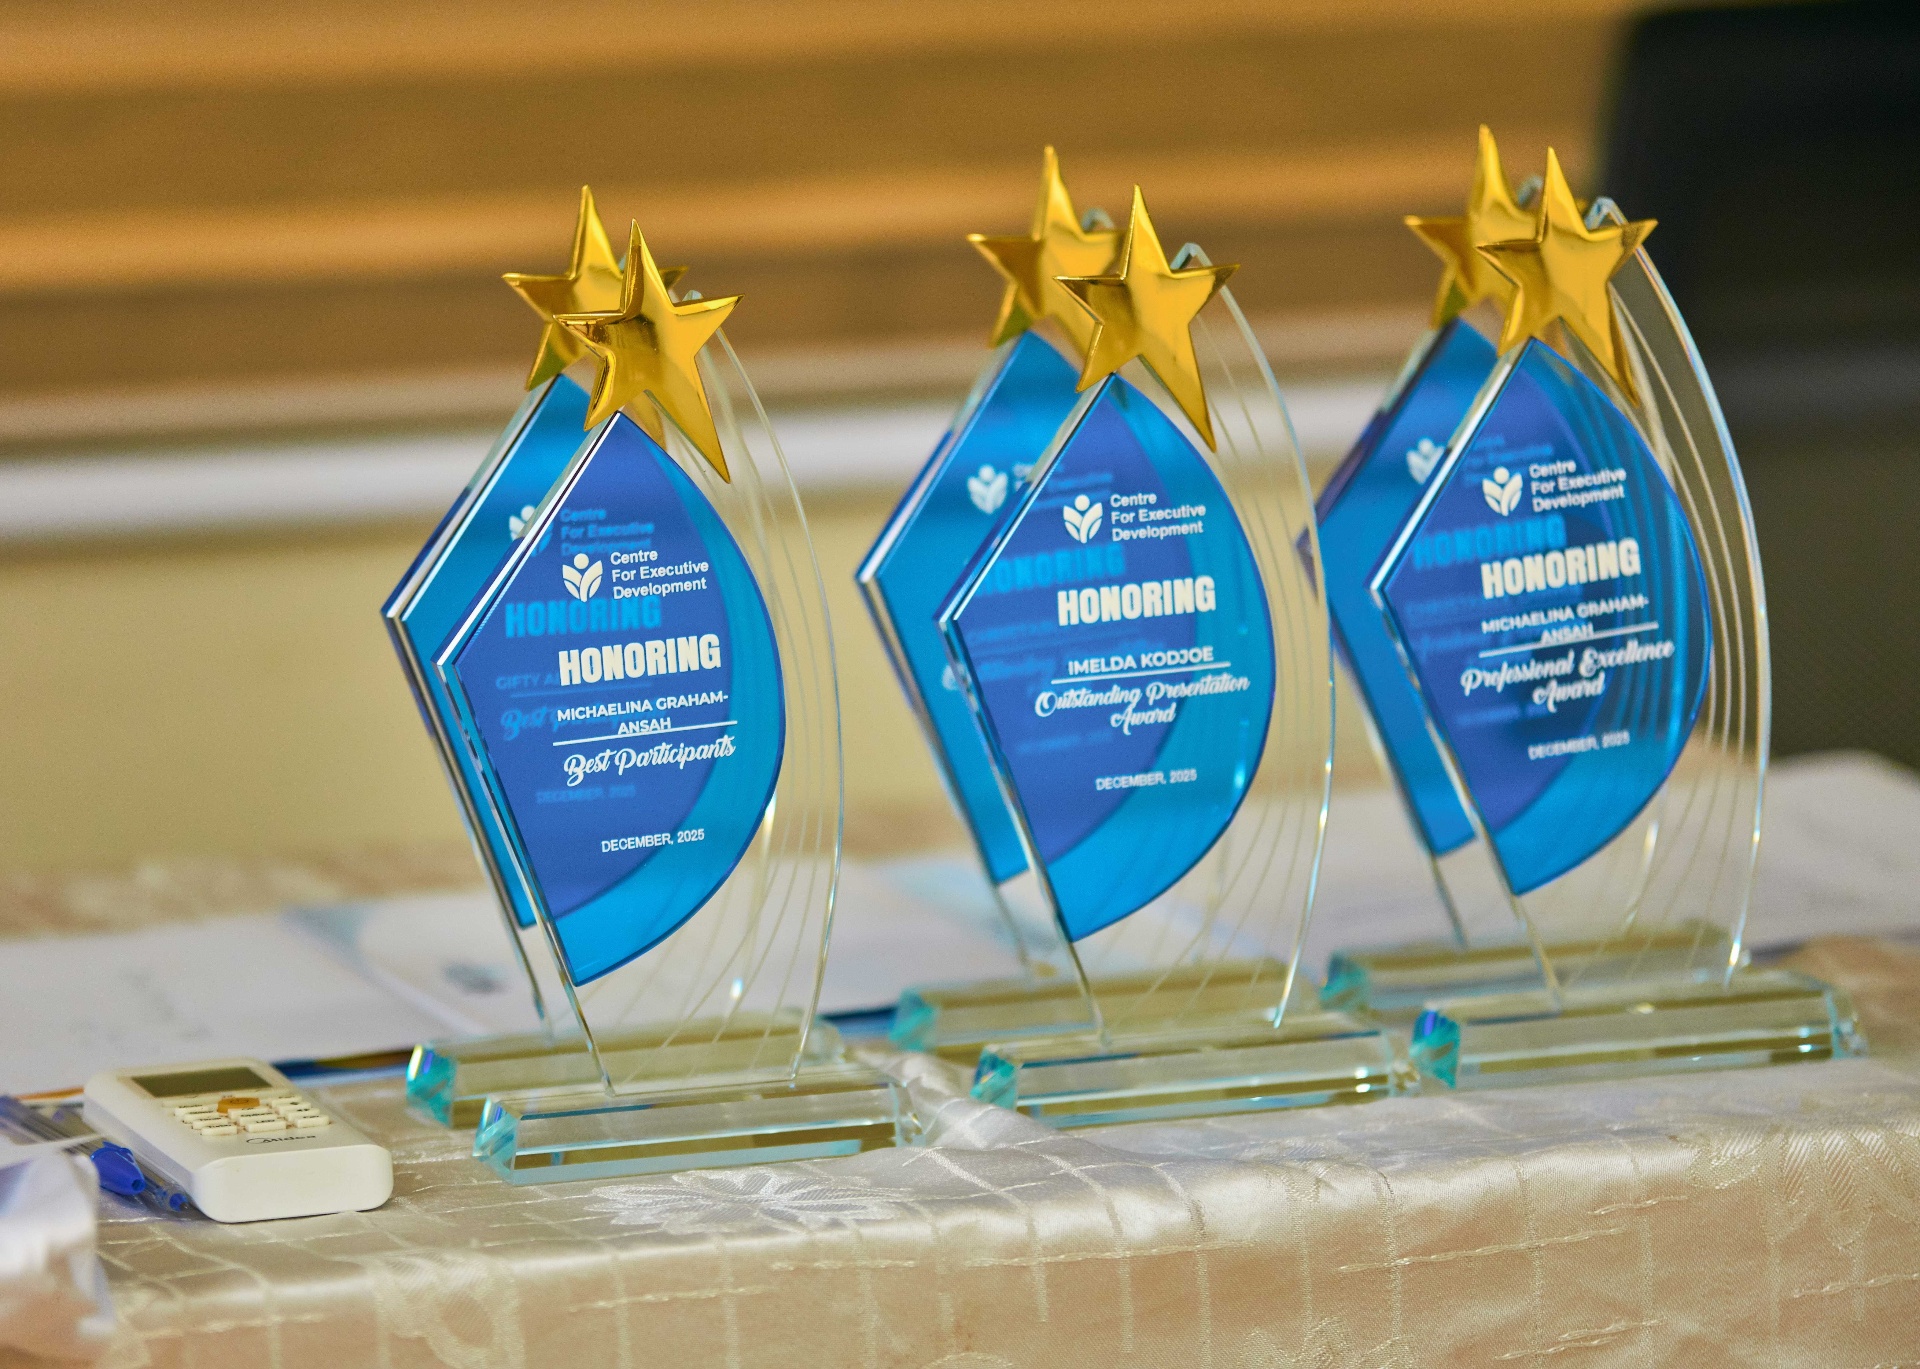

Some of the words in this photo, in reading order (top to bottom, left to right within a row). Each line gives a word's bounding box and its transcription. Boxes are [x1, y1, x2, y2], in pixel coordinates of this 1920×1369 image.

[1529, 459, 1577, 478] Centre
[1531, 481, 1554, 496] For
[1557, 467, 1627, 492] Executive
[1110, 492, 1157, 508] Centre
[1532, 484, 1625, 513] Development
[1111, 510, 1136, 524] For
[1138, 504, 1207, 522] Executive
[1112, 520, 1204, 542] Development
[610, 550, 658, 566] Centre
[612, 568, 637, 583] For
[640, 561, 709, 579] Executive
[1481, 537, 1641, 599] HONORING
[613, 577, 707, 600] Development
[1057, 575, 1216, 626] HONORING
[505, 597, 662, 638] HONORING
[1481, 606, 1575, 634] MICHAELINA
[1576, 593, 1649, 619] GRAHAM-
[1540, 623, 1594, 647] ANSAH
[558, 633, 722, 687] HONORING
[1068, 653, 1137, 676] IMELDA
[1140, 646, 1214, 669] KODJOE
[1460, 649, 1575, 697] Professional
[1579, 637, 1675, 678] Excellence
[557, 699, 653, 722] MICHAELINA
[656, 690, 729, 711] GRAHAM-
[1034, 684, 1143, 717] Outstanding
[1145, 672, 1250, 703] Presentation
[1532, 671, 1606, 713] Award
[617, 717, 671, 735] ANSAH
[1110, 702, 1177, 736] Award
[564, 749, 618, 787] Best
[614, 734, 737, 776] Participants
[1096, 771, 1167, 791] DECEMBER,
[1169, 768, 1197, 783] 2025
[601, 834, 674, 853] DECEMBER,
[677, 829, 705, 845] 2025
